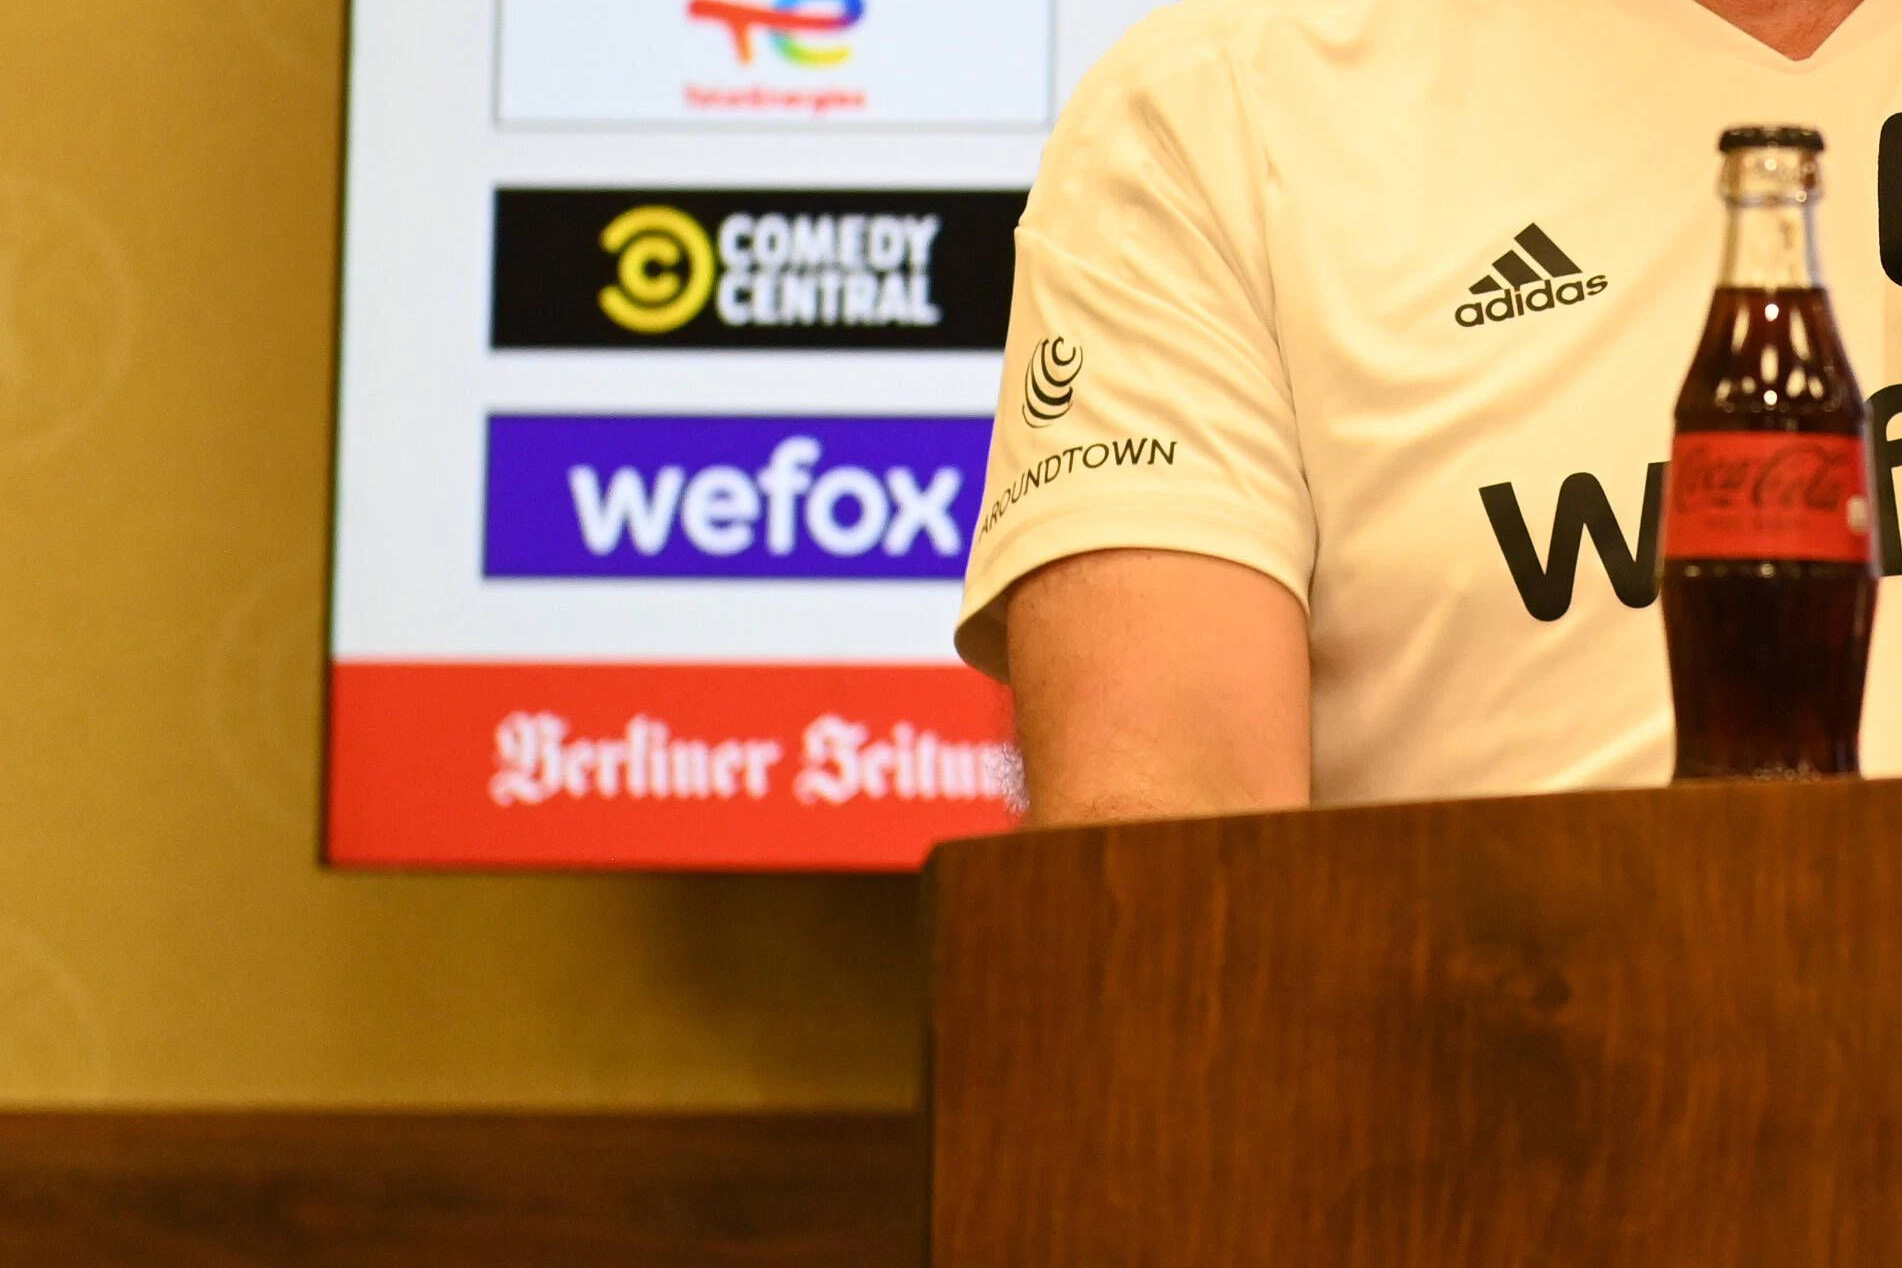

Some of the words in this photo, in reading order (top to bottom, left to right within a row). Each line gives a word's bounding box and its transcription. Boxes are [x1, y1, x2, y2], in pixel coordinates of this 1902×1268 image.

[719, 213, 940, 270] COMEDY
[717, 271, 942, 326] CENTRAL
[1454, 273, 1609, 328] adidas
[567, 436, 962, 557] wefox
[979, 438, 1177, 542] AROUNDTOWN
[489, 712, 784, 807] Berliner
[793, 713, 1022, 807] Zeitun
